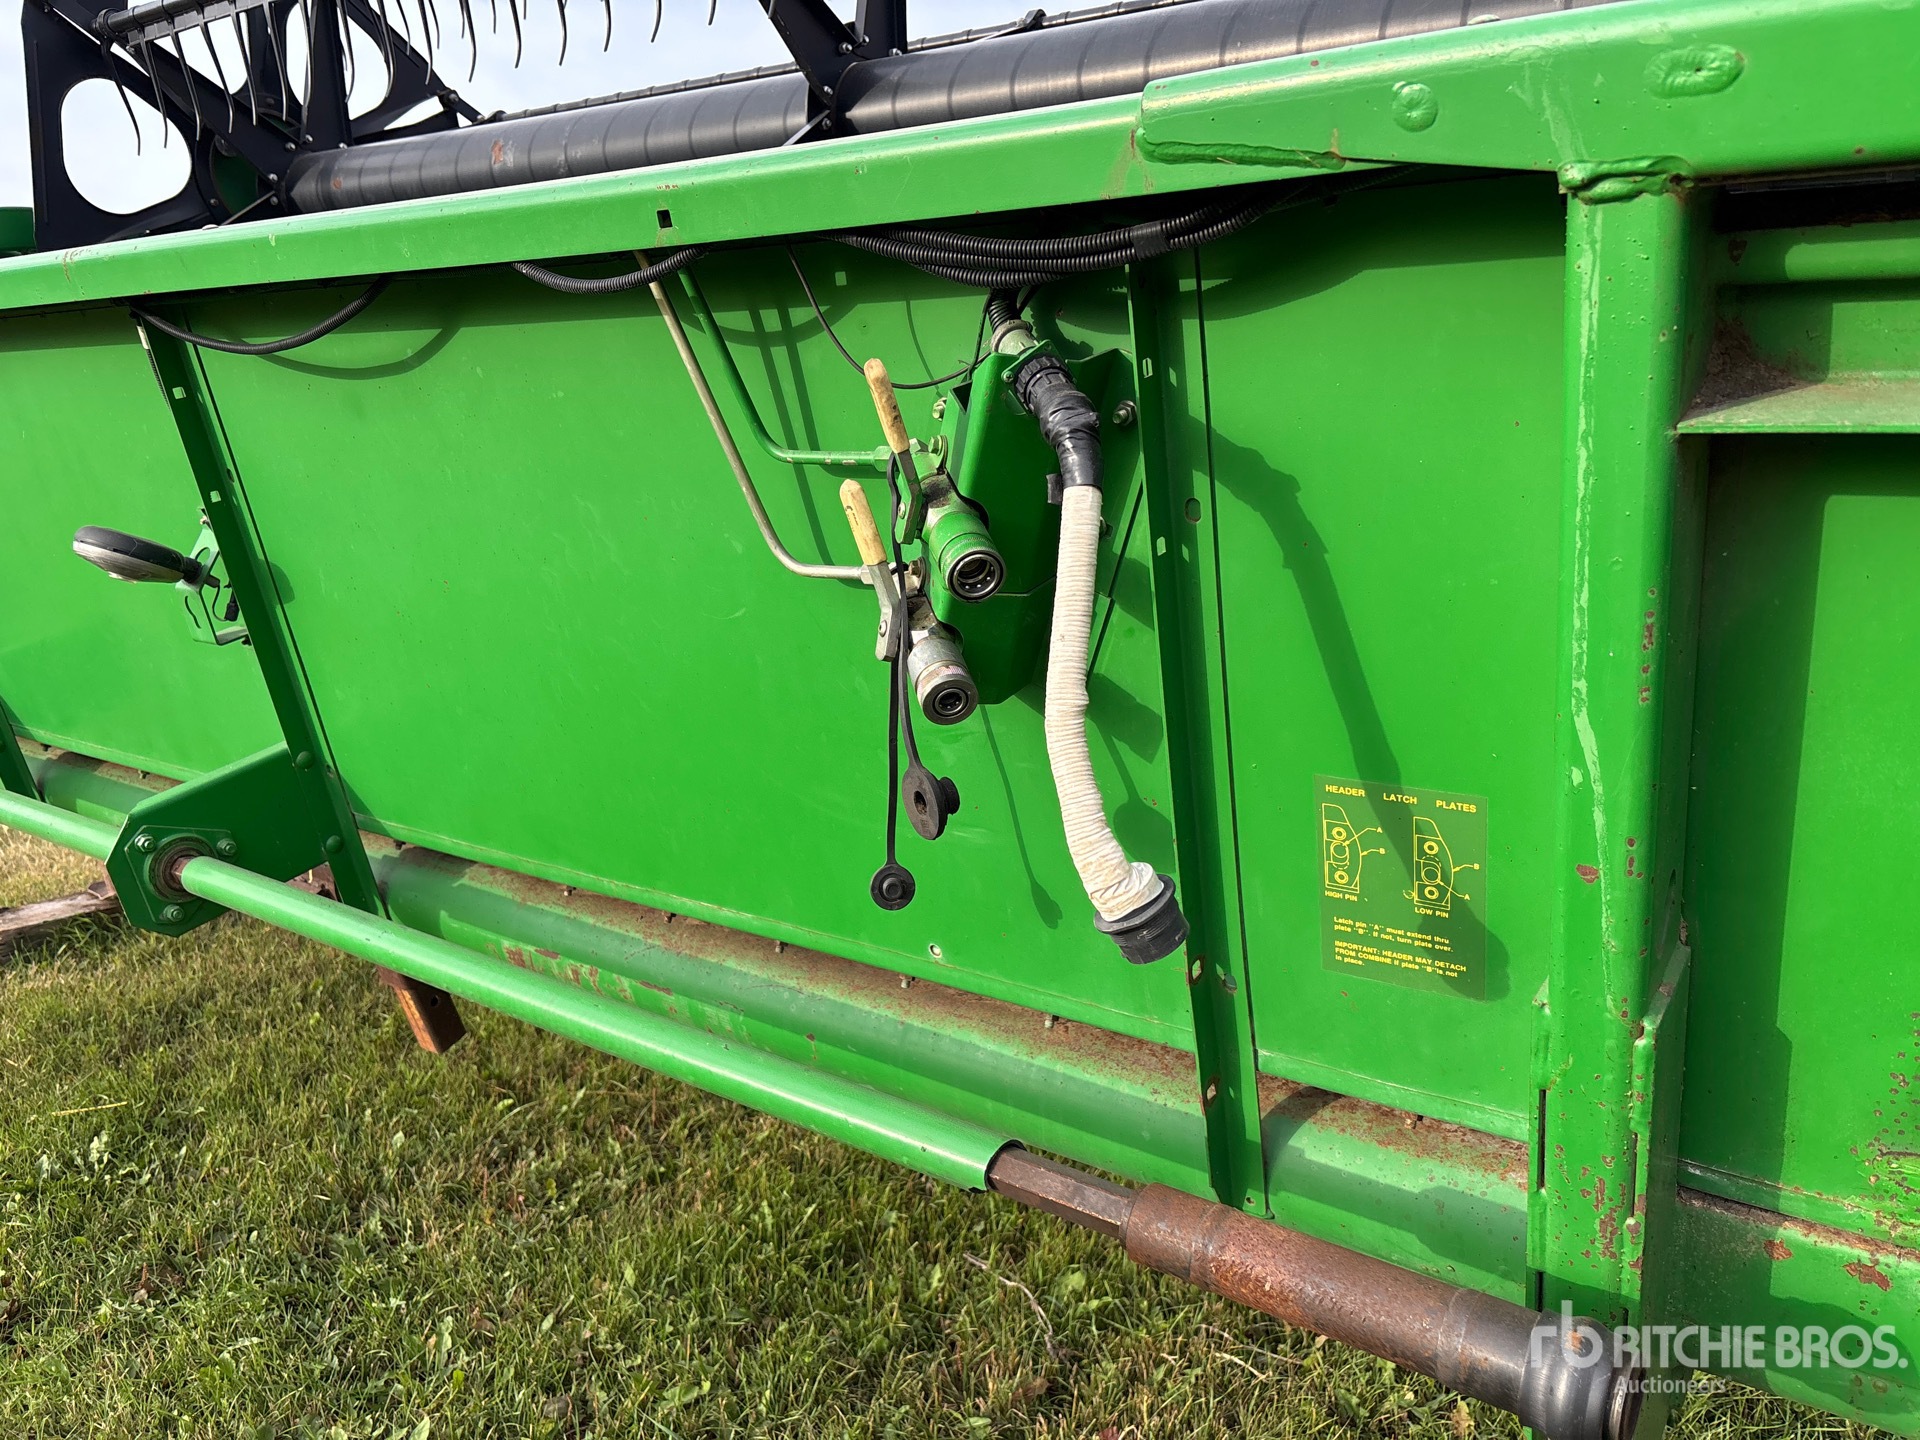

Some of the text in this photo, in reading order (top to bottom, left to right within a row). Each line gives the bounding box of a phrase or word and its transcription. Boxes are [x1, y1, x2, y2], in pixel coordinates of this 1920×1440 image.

[1325, 784, 1477, 813] HEADER LATCH PLATES
[1325, 890, 1358, 901] HIGH PIN
[1415, 906, 1449, 918] LOW PIN
[1334, 916, 1353, 925] Latch
[1386, 927, 1404, 936] must
[1406, 931, 1431, 940] extend
[1434, 936, 1449, 944] thru
[1334, 924, 1351, 933] plate
[1397, 936, 1412, 944] turn
[1414, 940, 1432, 949] plate
[1434, 944, 1453, 952] over.
[1334, 940, 1466, 972] IMPORTANT: HEADER MAY DETACH
[1335, 948, 1356, 956] FROM
[1358, 952, 1392, 965] COMBINE
[1401, 961, 1420, 970] plate
[1445, 970, 1458, 978] not
[1344, 956, 1365, 966] place.
